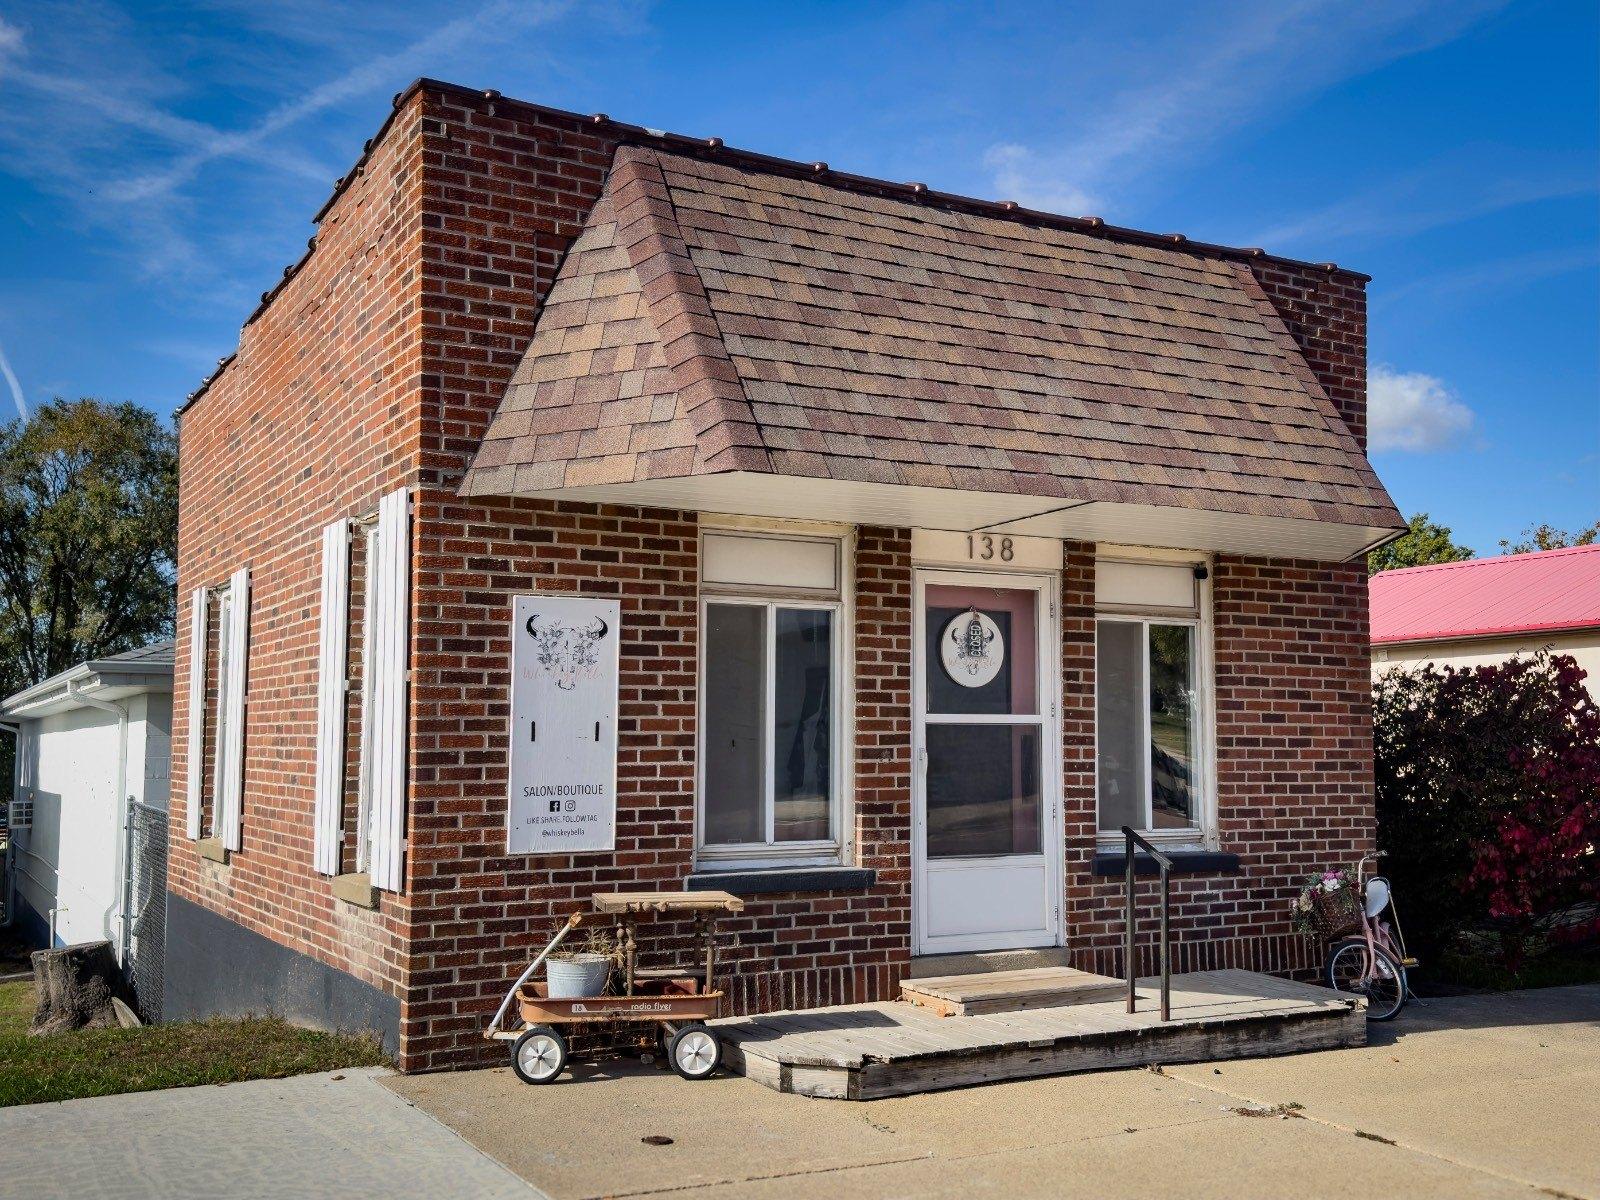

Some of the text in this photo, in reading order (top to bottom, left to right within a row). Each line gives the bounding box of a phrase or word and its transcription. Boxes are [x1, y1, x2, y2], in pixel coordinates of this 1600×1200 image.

[966, 535, 1014, 562] 138
[970, 625, 981, 656] CLOSED
[523, 784, 604, 798] SALON/BOUTIQUE
[541, 828, 585, 838] @whiskeybella
[631, 1002, 672, 1011] radio flyer
